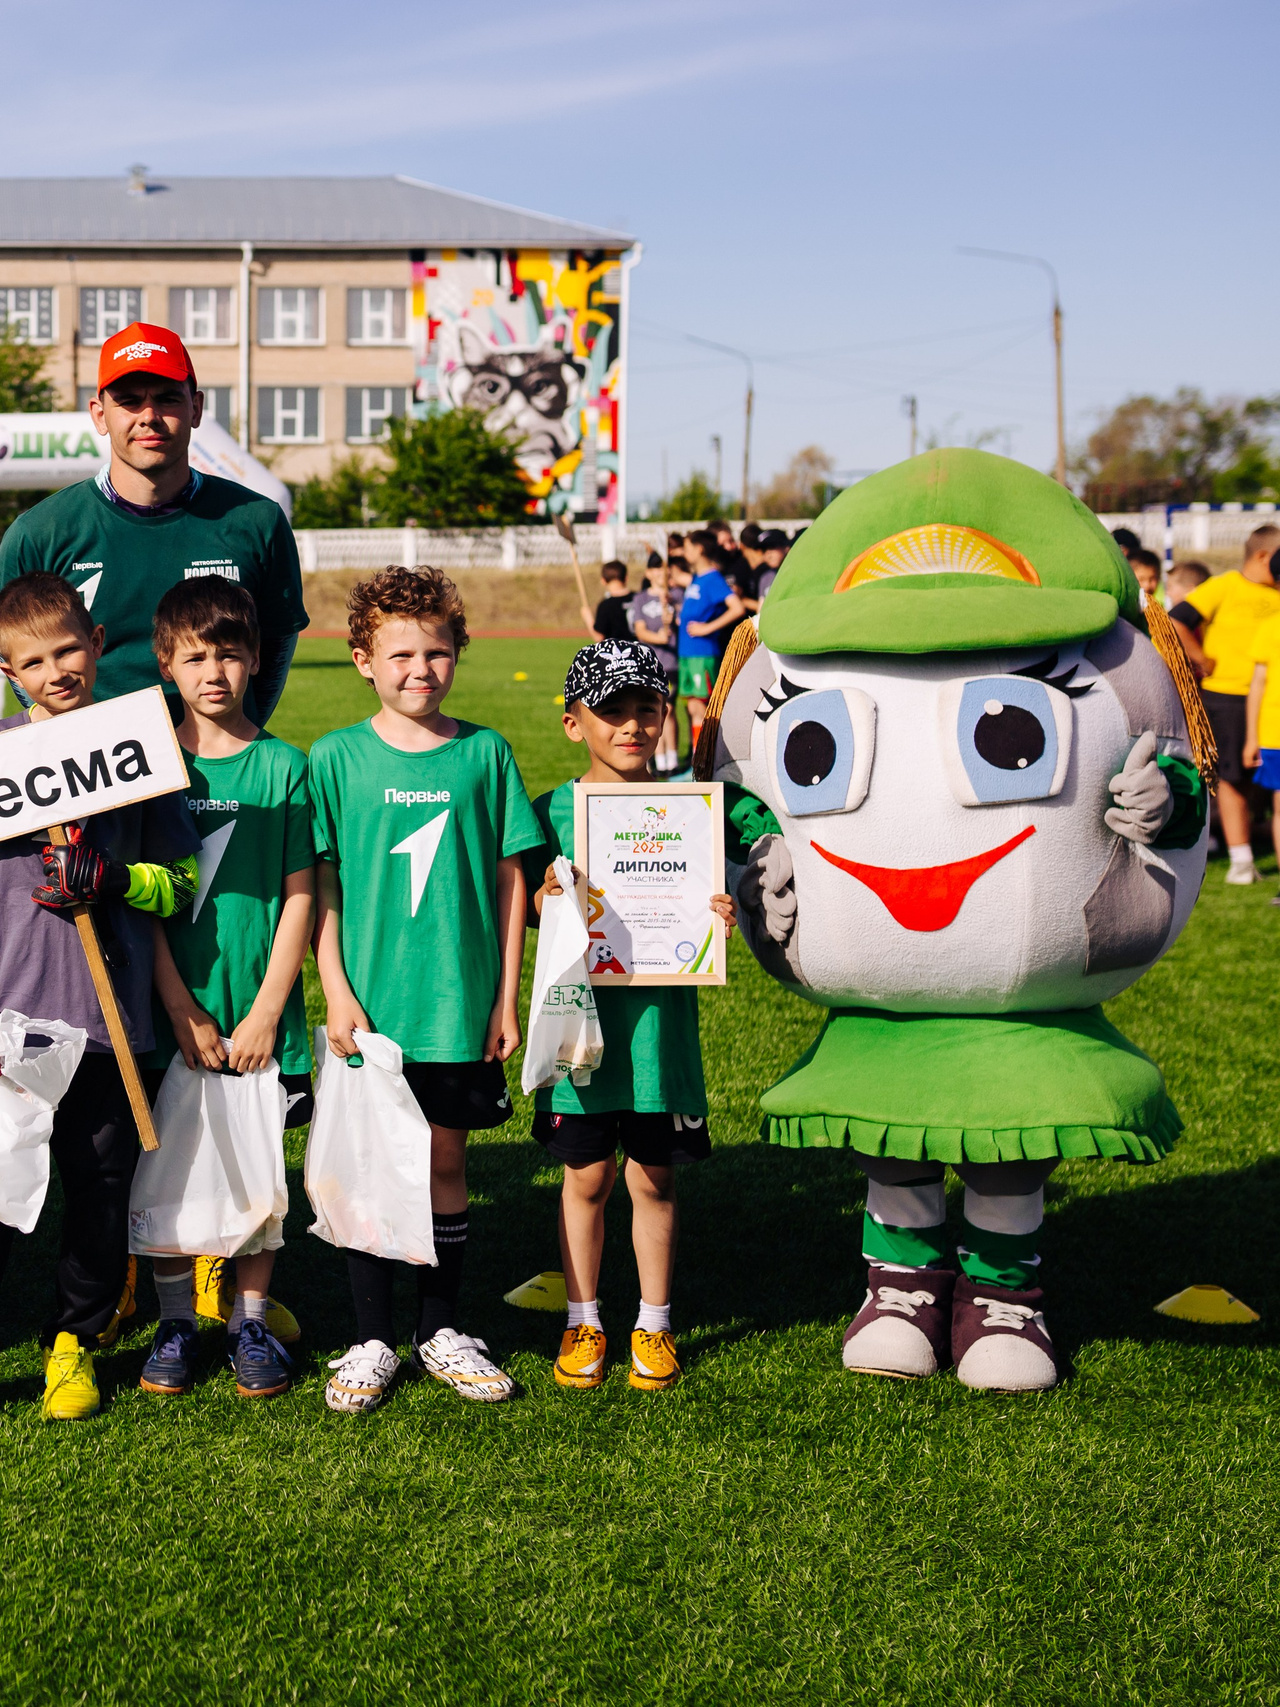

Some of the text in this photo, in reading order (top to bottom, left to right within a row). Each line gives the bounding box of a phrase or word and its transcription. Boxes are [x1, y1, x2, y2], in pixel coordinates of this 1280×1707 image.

[126, 349, 153, 361] 2025
[72, 562, 103, 571] Первые
[605, 659, 638, 672] adidas
[384, 788, 451, 807] Первые
[185, 796, 239, 815] ервые
[632, 841, 664, 854] 2025
[613, 861, 687, 873] ДИПЛОМ
